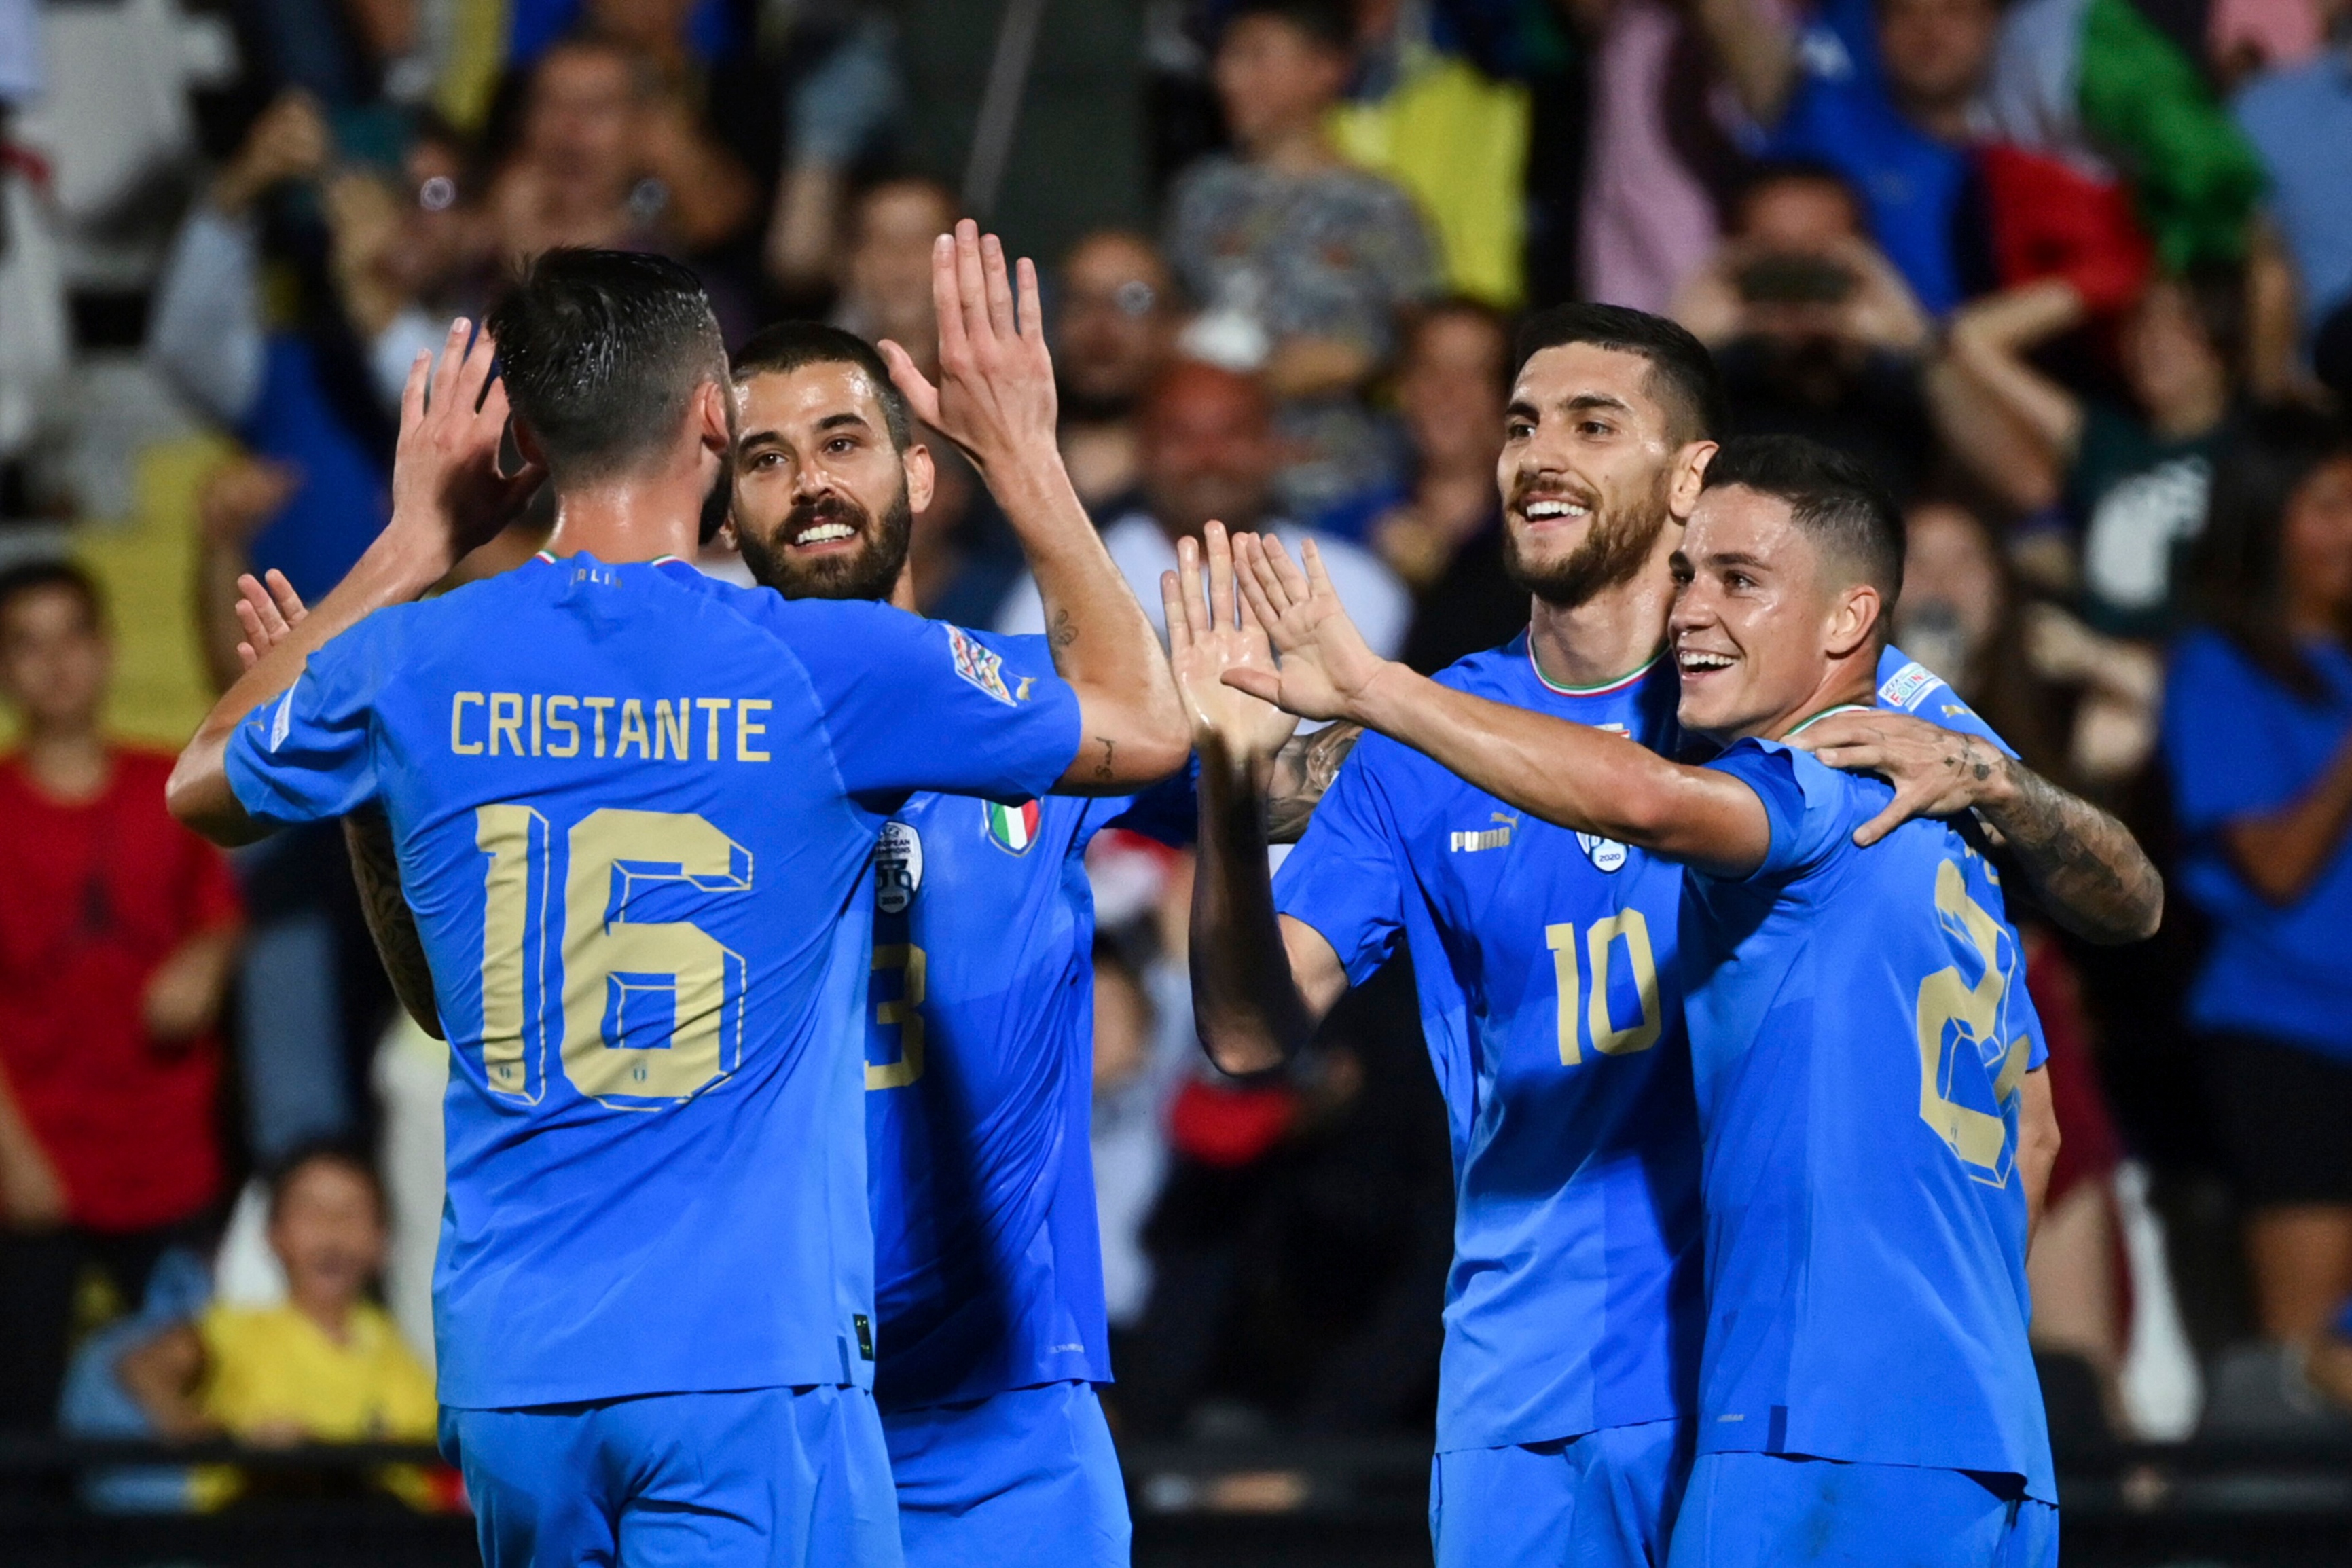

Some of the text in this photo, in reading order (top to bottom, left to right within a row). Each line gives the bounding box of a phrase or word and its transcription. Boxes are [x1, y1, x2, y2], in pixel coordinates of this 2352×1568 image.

[451, 691, 772, 761] CRISTANTE
[1451, 826, 1510, 852] PUMA
[1599, 853, 1621, 862] 2020
[475, 804, 753, 1111] 16
[1545, 907, 1662, 1066] 10
